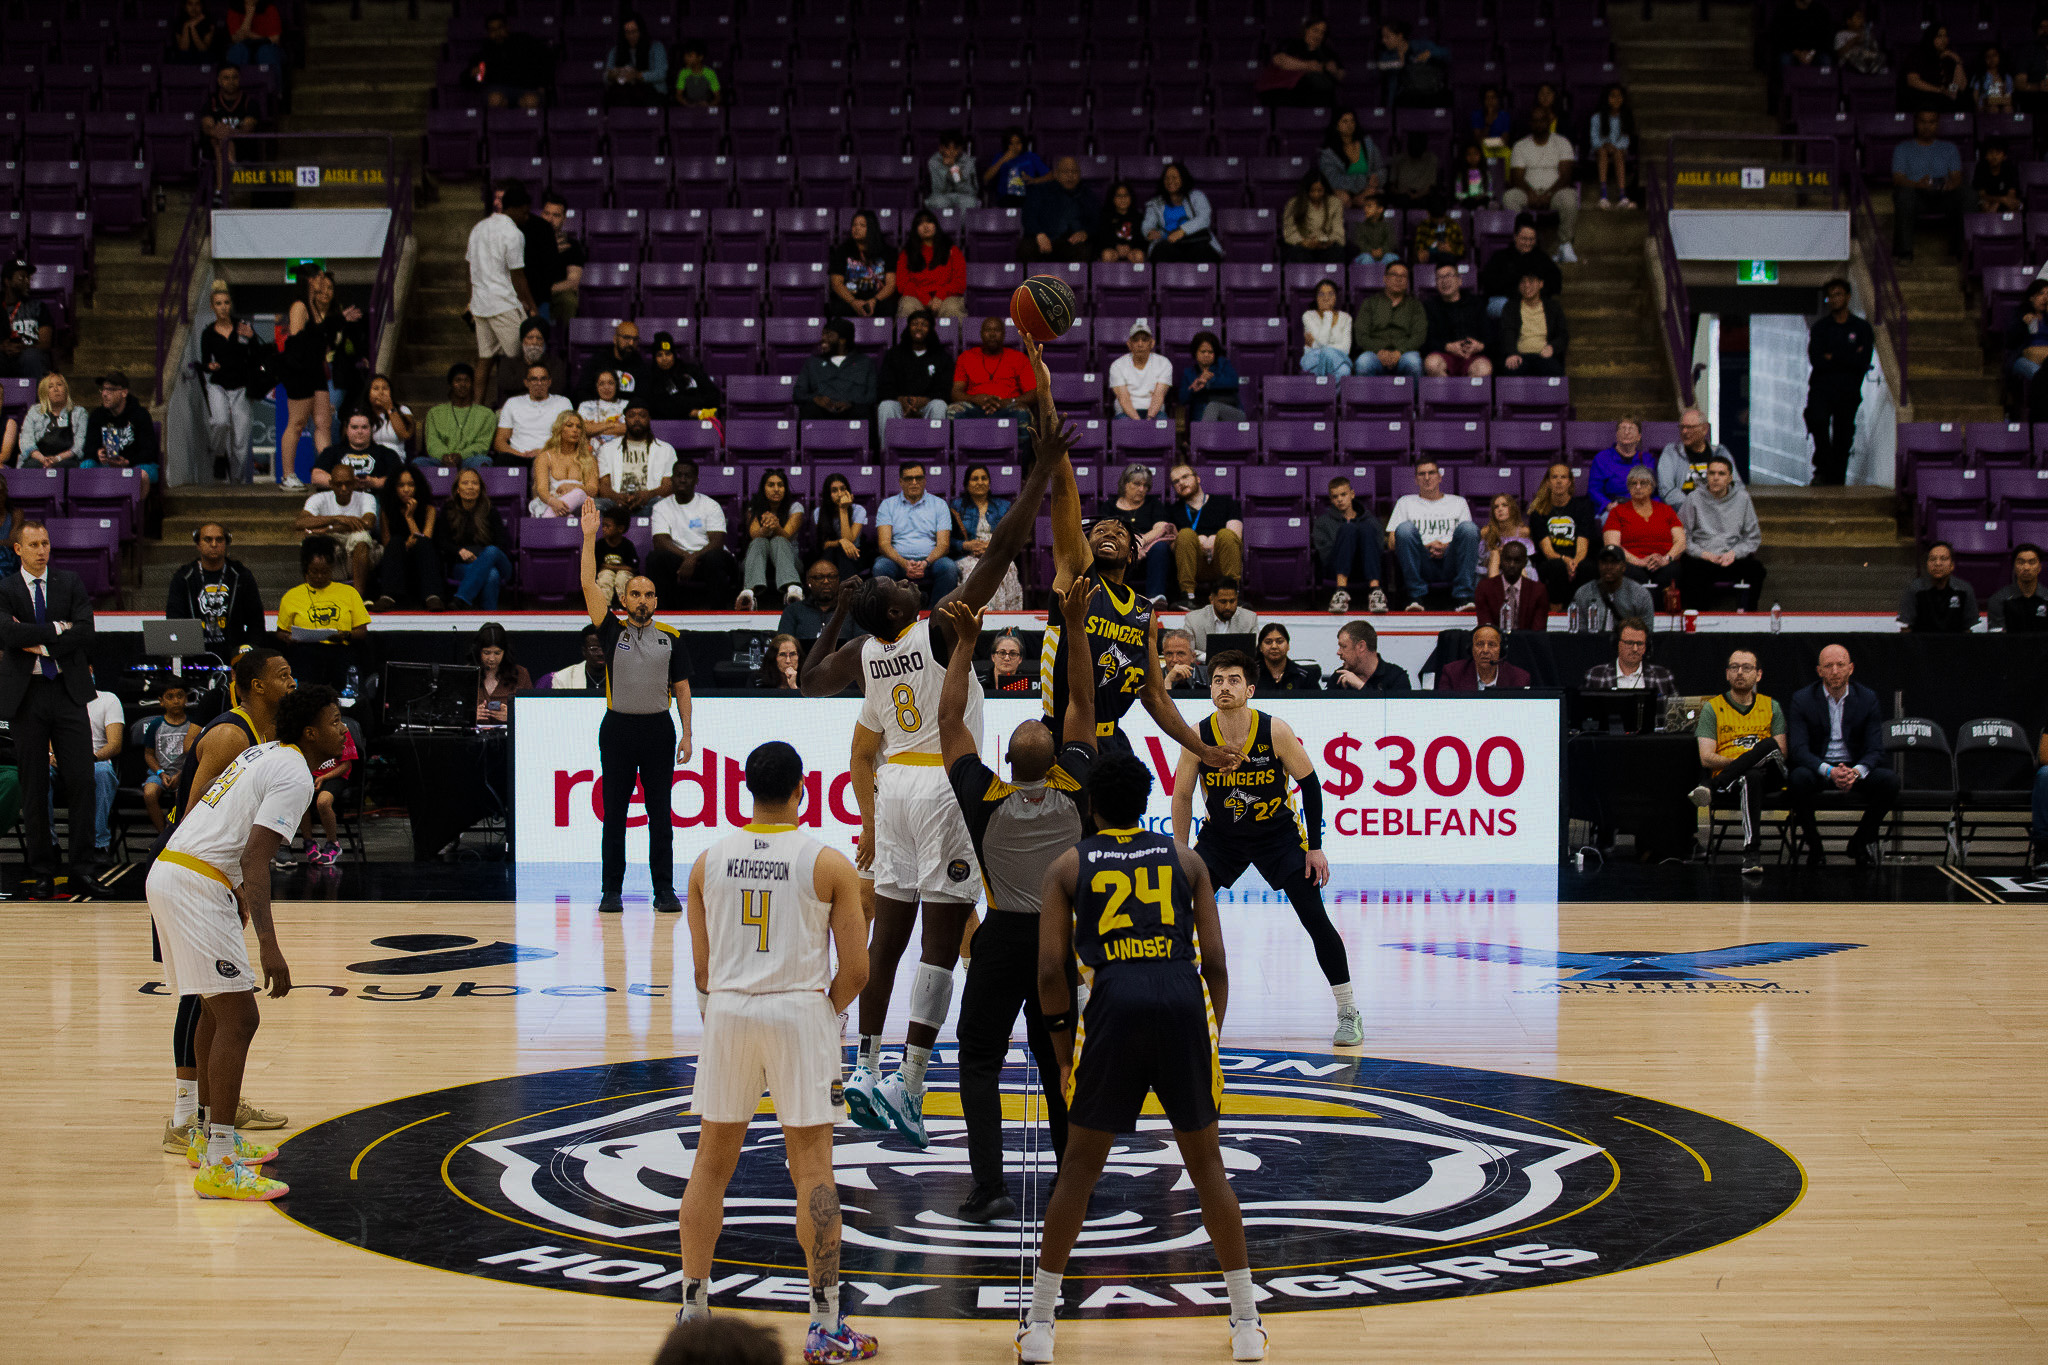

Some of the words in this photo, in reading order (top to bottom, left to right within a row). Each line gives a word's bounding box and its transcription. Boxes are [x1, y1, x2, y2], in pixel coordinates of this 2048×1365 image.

[232, 170, 266, 184] AISLE
[301, 170, 316, 184] 13
[324, 169, 358, 183] AISLE
[869, 651, 923, 679] ODURO
[891, 683, 922, 743] 8
[1891, 724, 1932, 737] BRAMPTON
[1972, 725, 2013, 738] BRAMPTON
[1322, 732, 1524, 800] $300
[1206, 769, 1275, 787] STINGERS
[1335, 808, 1517, 836] CEBLFANS
[1103, 851, 1128, 860] play
[1128, 847, 1168, 859] alberta
[727, 859, 789, 880] WEATHERSPOON
[1090, 865, 1175, 936] 24
[741, 889, 772, 953] 4
[1103, 936, 1173, 961] LINDSEY
[1538, 982, 1784, 990] ANTHEM
[478, 1245, 941, 1306] HONEY
[977, 1243, 1600, 1310] BADGERS
